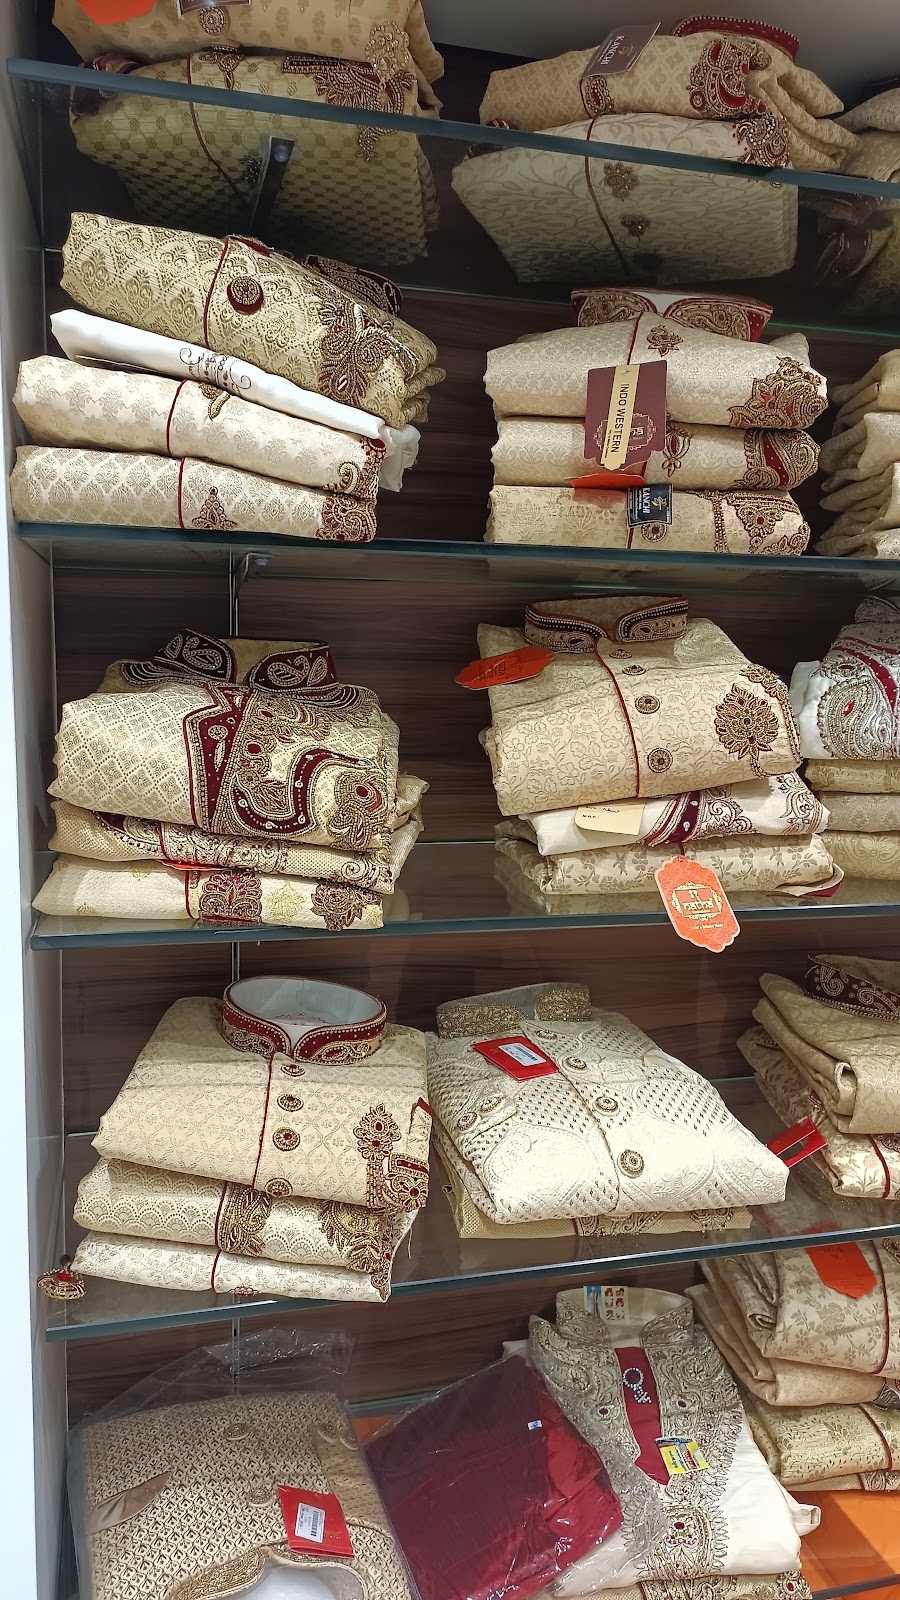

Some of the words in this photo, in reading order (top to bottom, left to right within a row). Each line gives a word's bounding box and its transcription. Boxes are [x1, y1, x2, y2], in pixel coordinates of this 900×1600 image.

[600, 35, 625, 65] KANCHI
[616, 383, 630, 406] INDO
[610, 408, 626, 453] WESTERN
